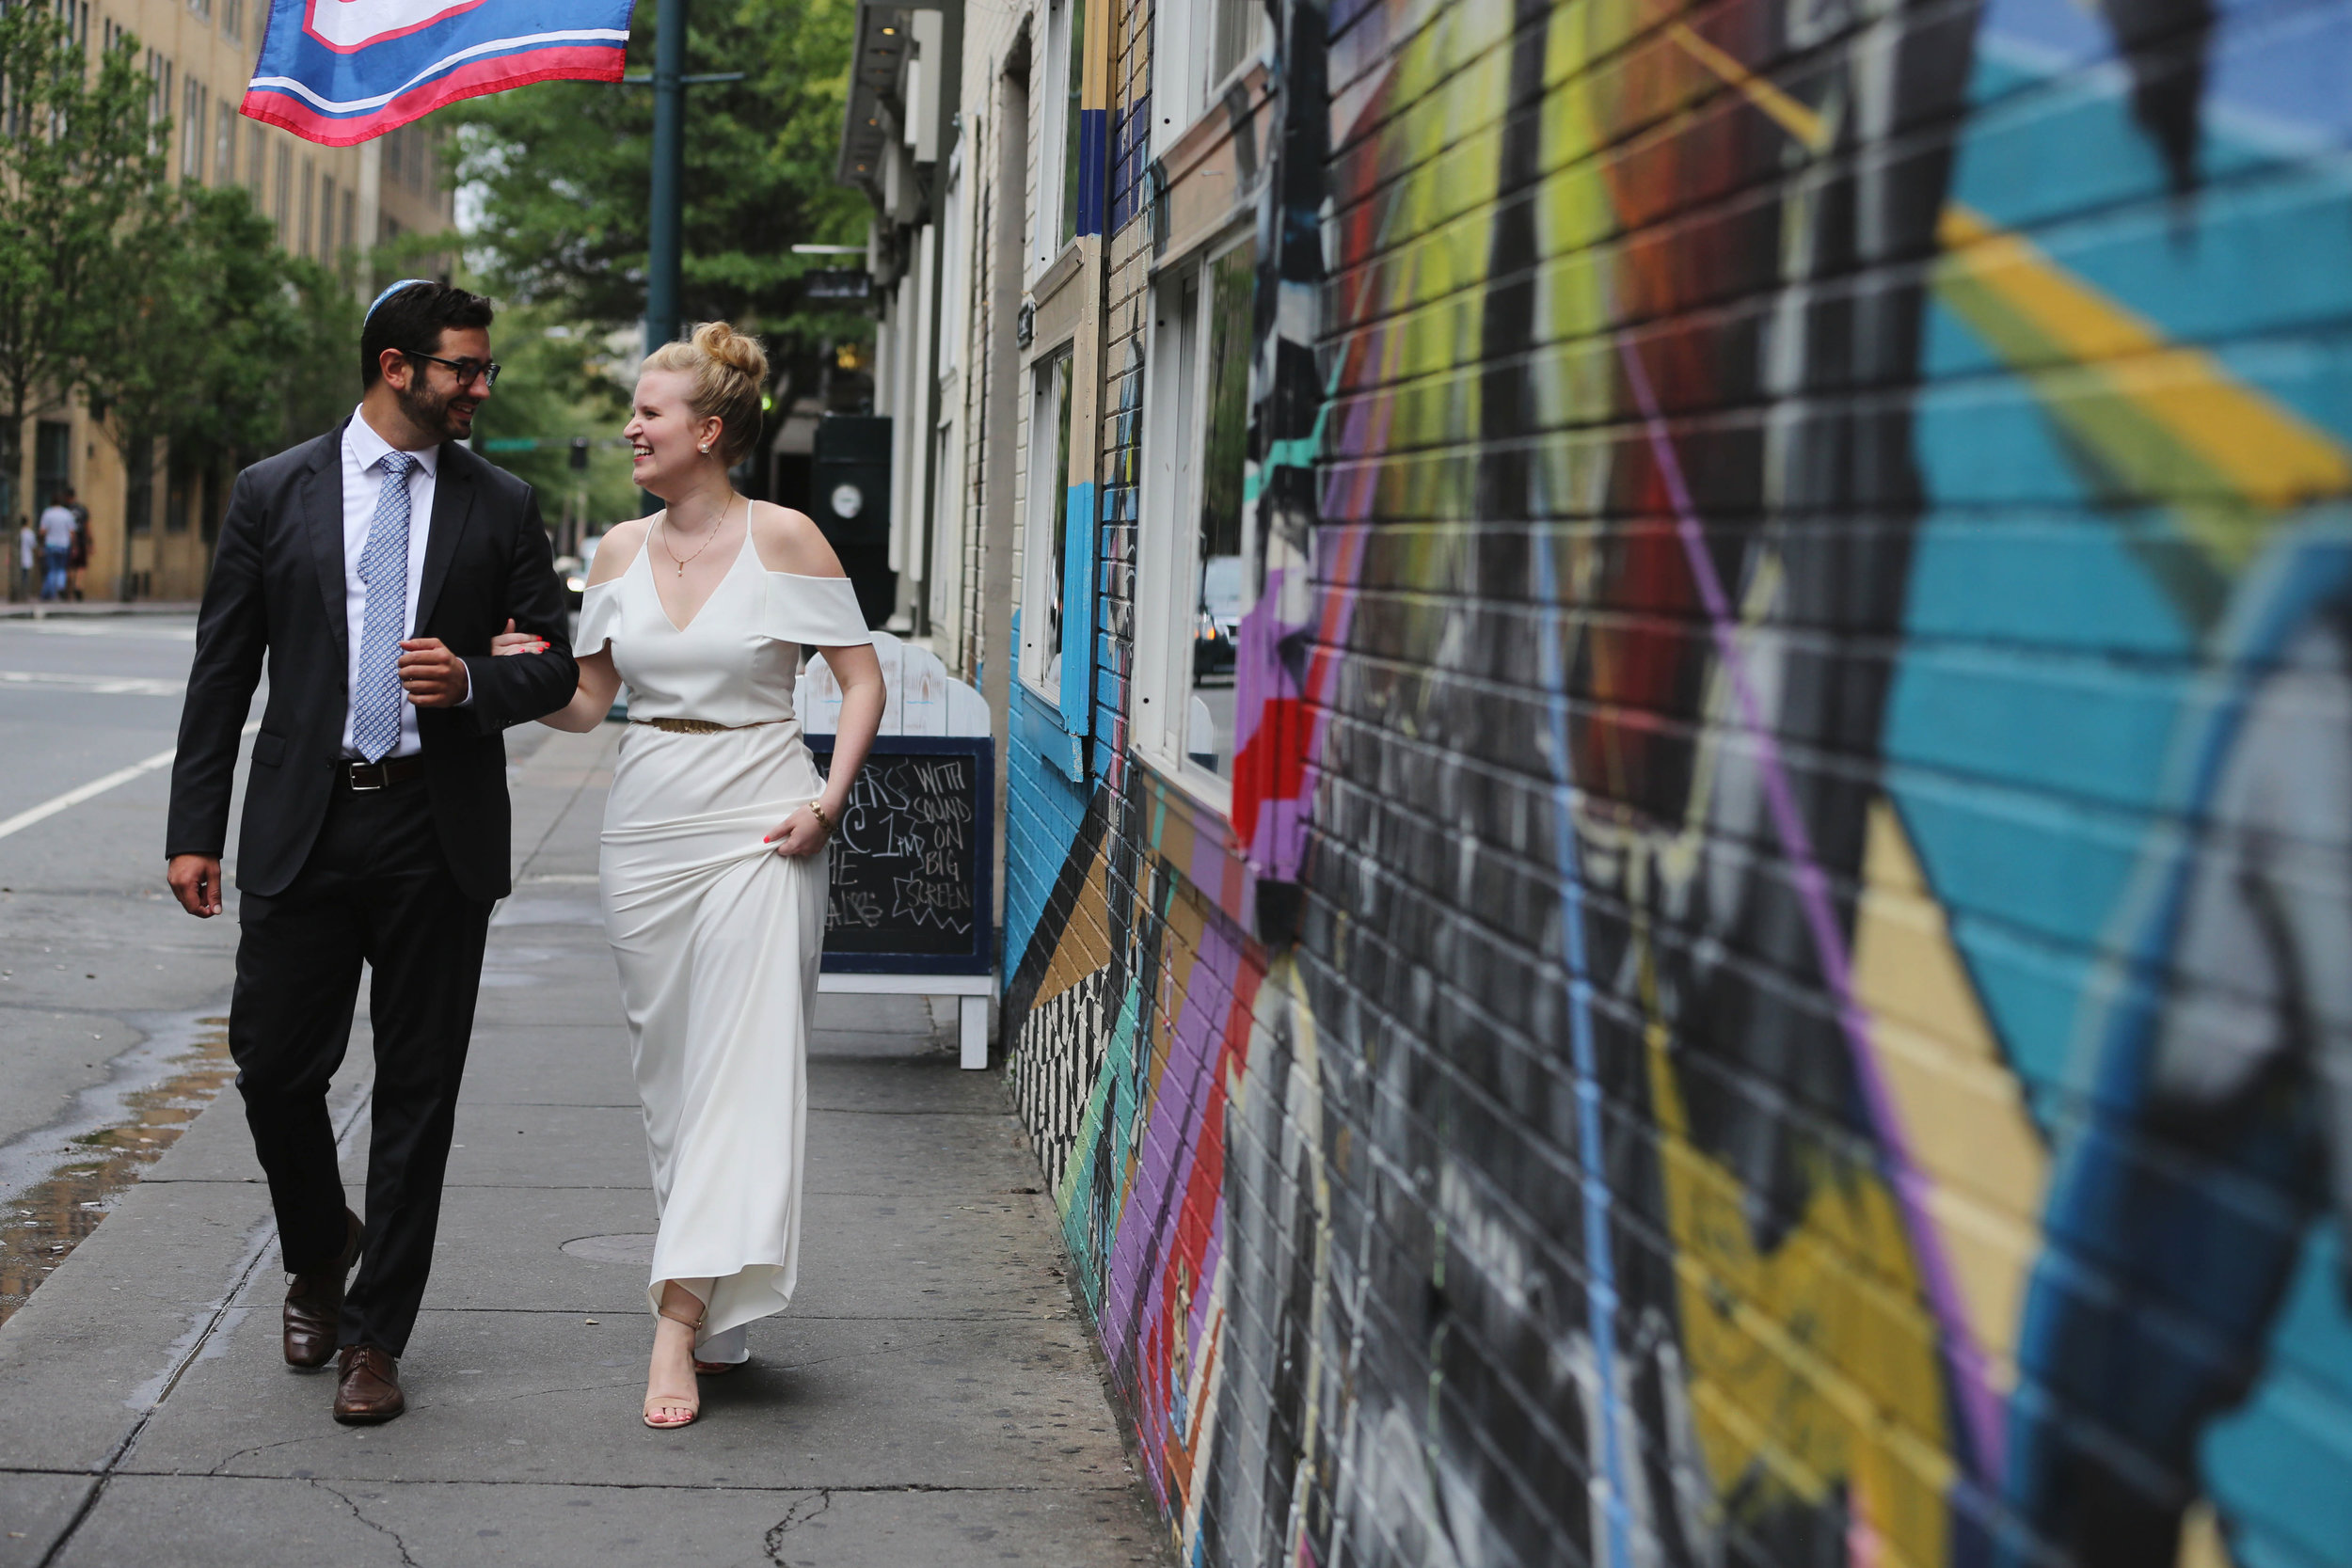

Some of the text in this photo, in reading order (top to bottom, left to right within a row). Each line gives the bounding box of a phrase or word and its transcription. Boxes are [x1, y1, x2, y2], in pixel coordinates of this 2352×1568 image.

[913, 760, 965, 796] WITH
[913, 796, 972, 823] SOUND
[933, 819, 964, 850] ON
[926, 849, 960, 881] BIG
[906, 879, 971, 911] SCREEN
